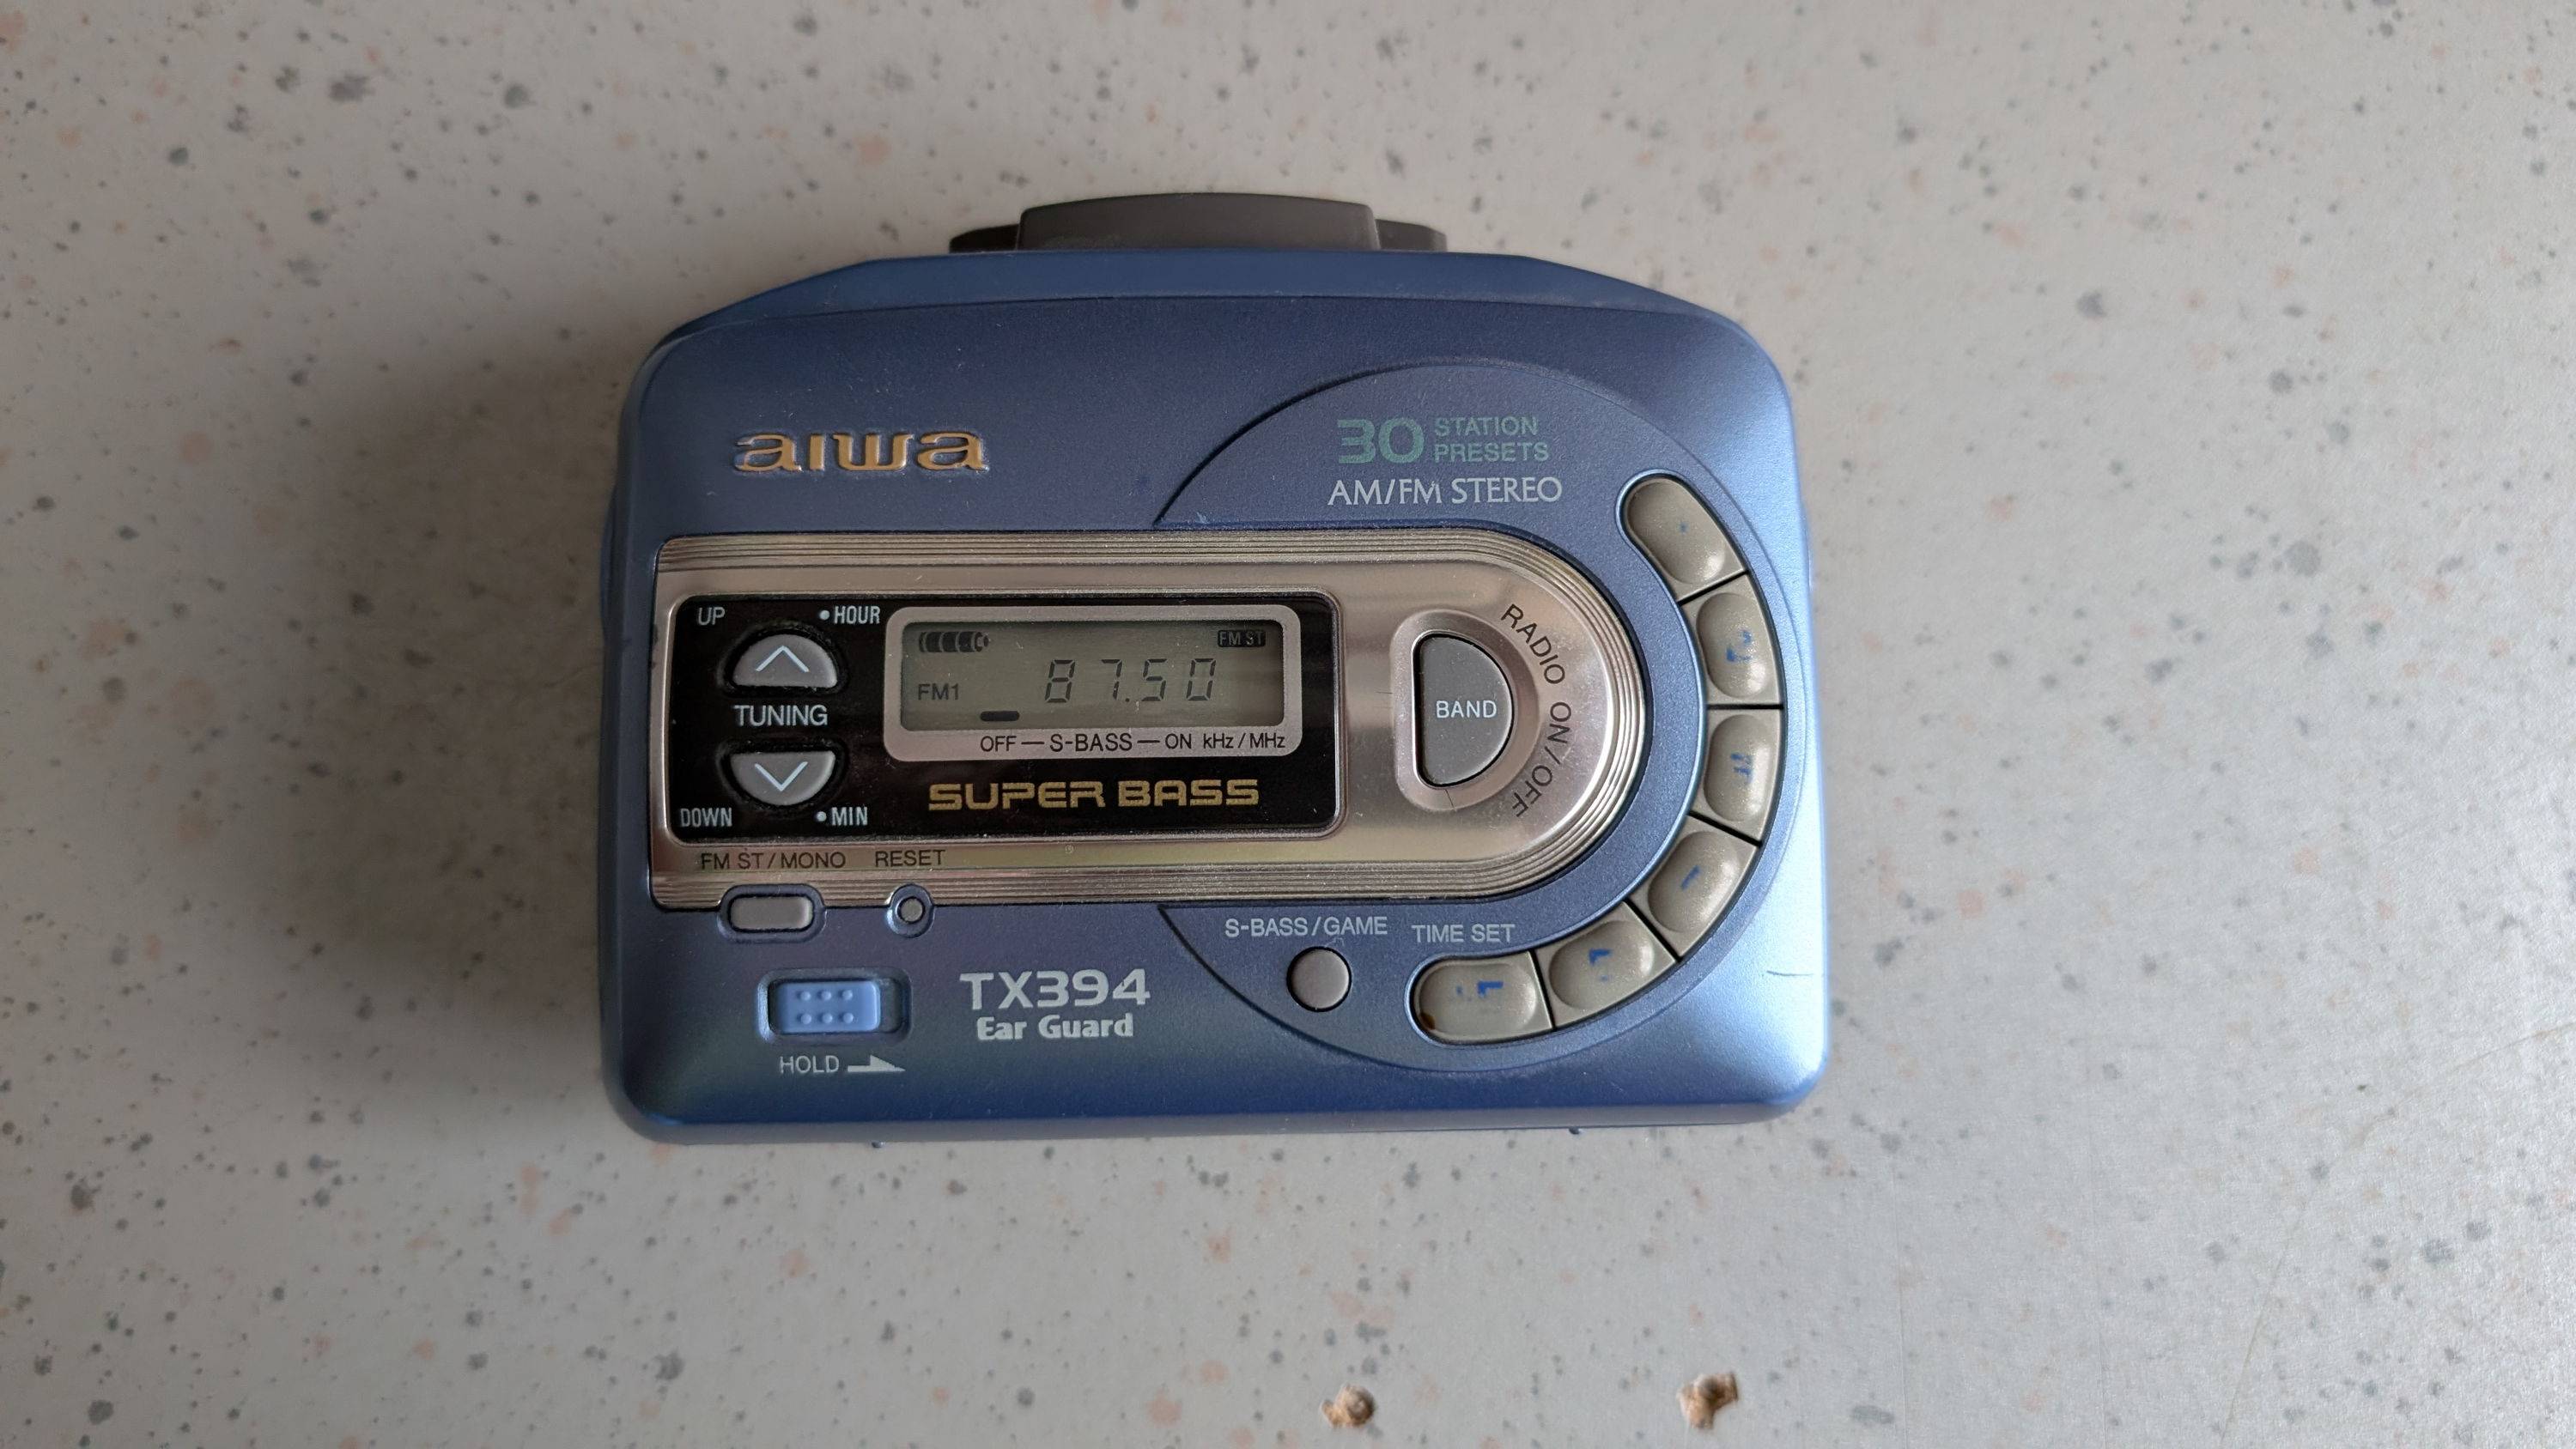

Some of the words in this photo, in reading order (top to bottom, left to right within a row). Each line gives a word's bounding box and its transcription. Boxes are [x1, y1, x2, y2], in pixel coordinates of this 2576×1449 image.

[1434, 415, 1539, 437] STATION
[1337, 417, 1425, 464] 30
[1434, 442, 1549, 463] PRESETS
[1327, 478, 1443, 506] AM/FM
[1451, 476, 1563, 504] STEREO
[697, 606, 726, 626] UP
[834, 605, 881, 625] HOUR
[1218, 632, 1241, 646] FM
[1245, 630, 1265, 646] ST
[1501, 603, 1565, 684] RADIO
[1044, 658, 1217, 704] 87.50
[917, 683, 959, 700] FM1
[734, 704, 828, 726] TUNING
[1436, 700, 1497, 718] BAND
[981, 736, 1017, 752] OFF
[1164, 733, 1192, 749] ON
[928, 780, 1106, 810] SUPER
[1118, 779, 1260, 807] BASS
[680, 807, 732, 828] DOWN
[831, 806, 868, 826] MIN
[701, 852, 730, 870] FM
[875, 849, 945, 867] RESET
[1411, 924, 1465, 943] TIME
[1471, 924, 1516, 943] SET
[959, 968, 1151, 1010] TX394
[976, 1016, 1028, 1040] Ear
[1038, 1013, 1134, 1039] Guard
[779, 1055, 840, 1073] HOLD
